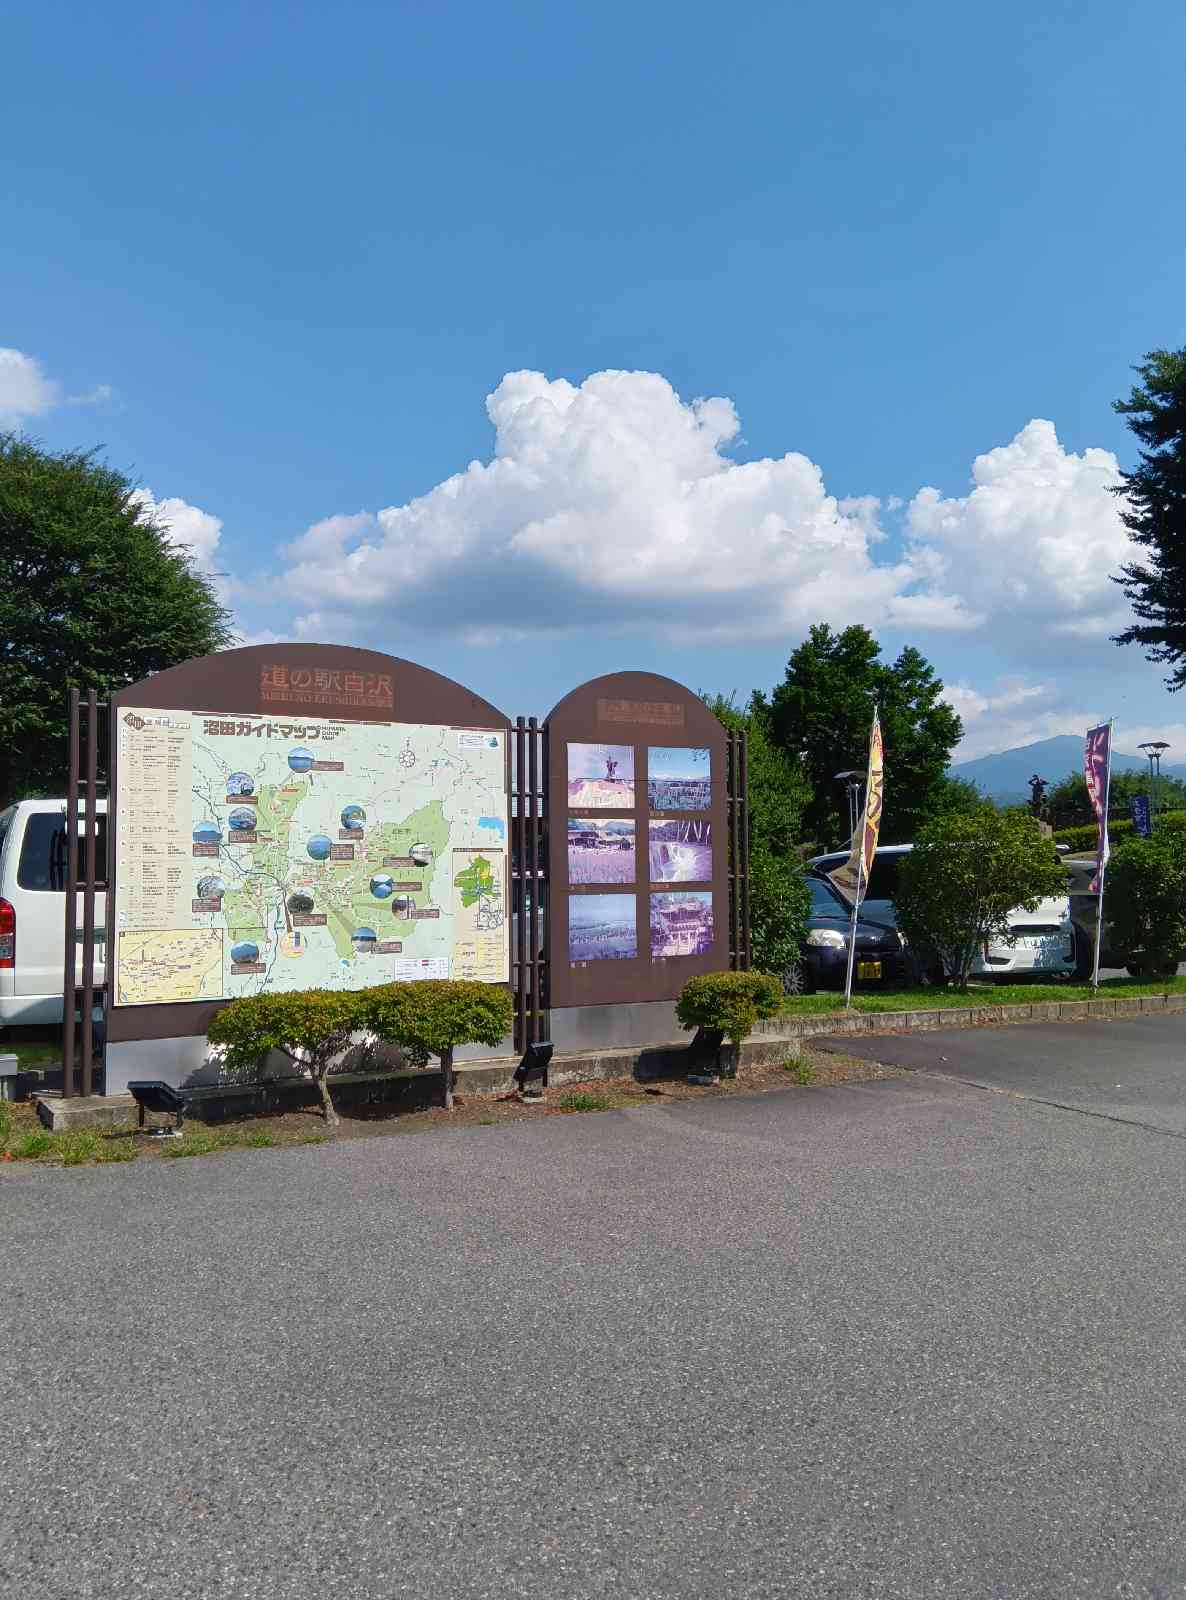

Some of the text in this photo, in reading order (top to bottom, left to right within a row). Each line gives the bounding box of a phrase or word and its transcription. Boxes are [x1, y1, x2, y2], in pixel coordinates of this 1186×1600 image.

[261, 664, 393, 696] 道の駅白沢
[203, 719, 321, 740] 沼田ガイドマップ
